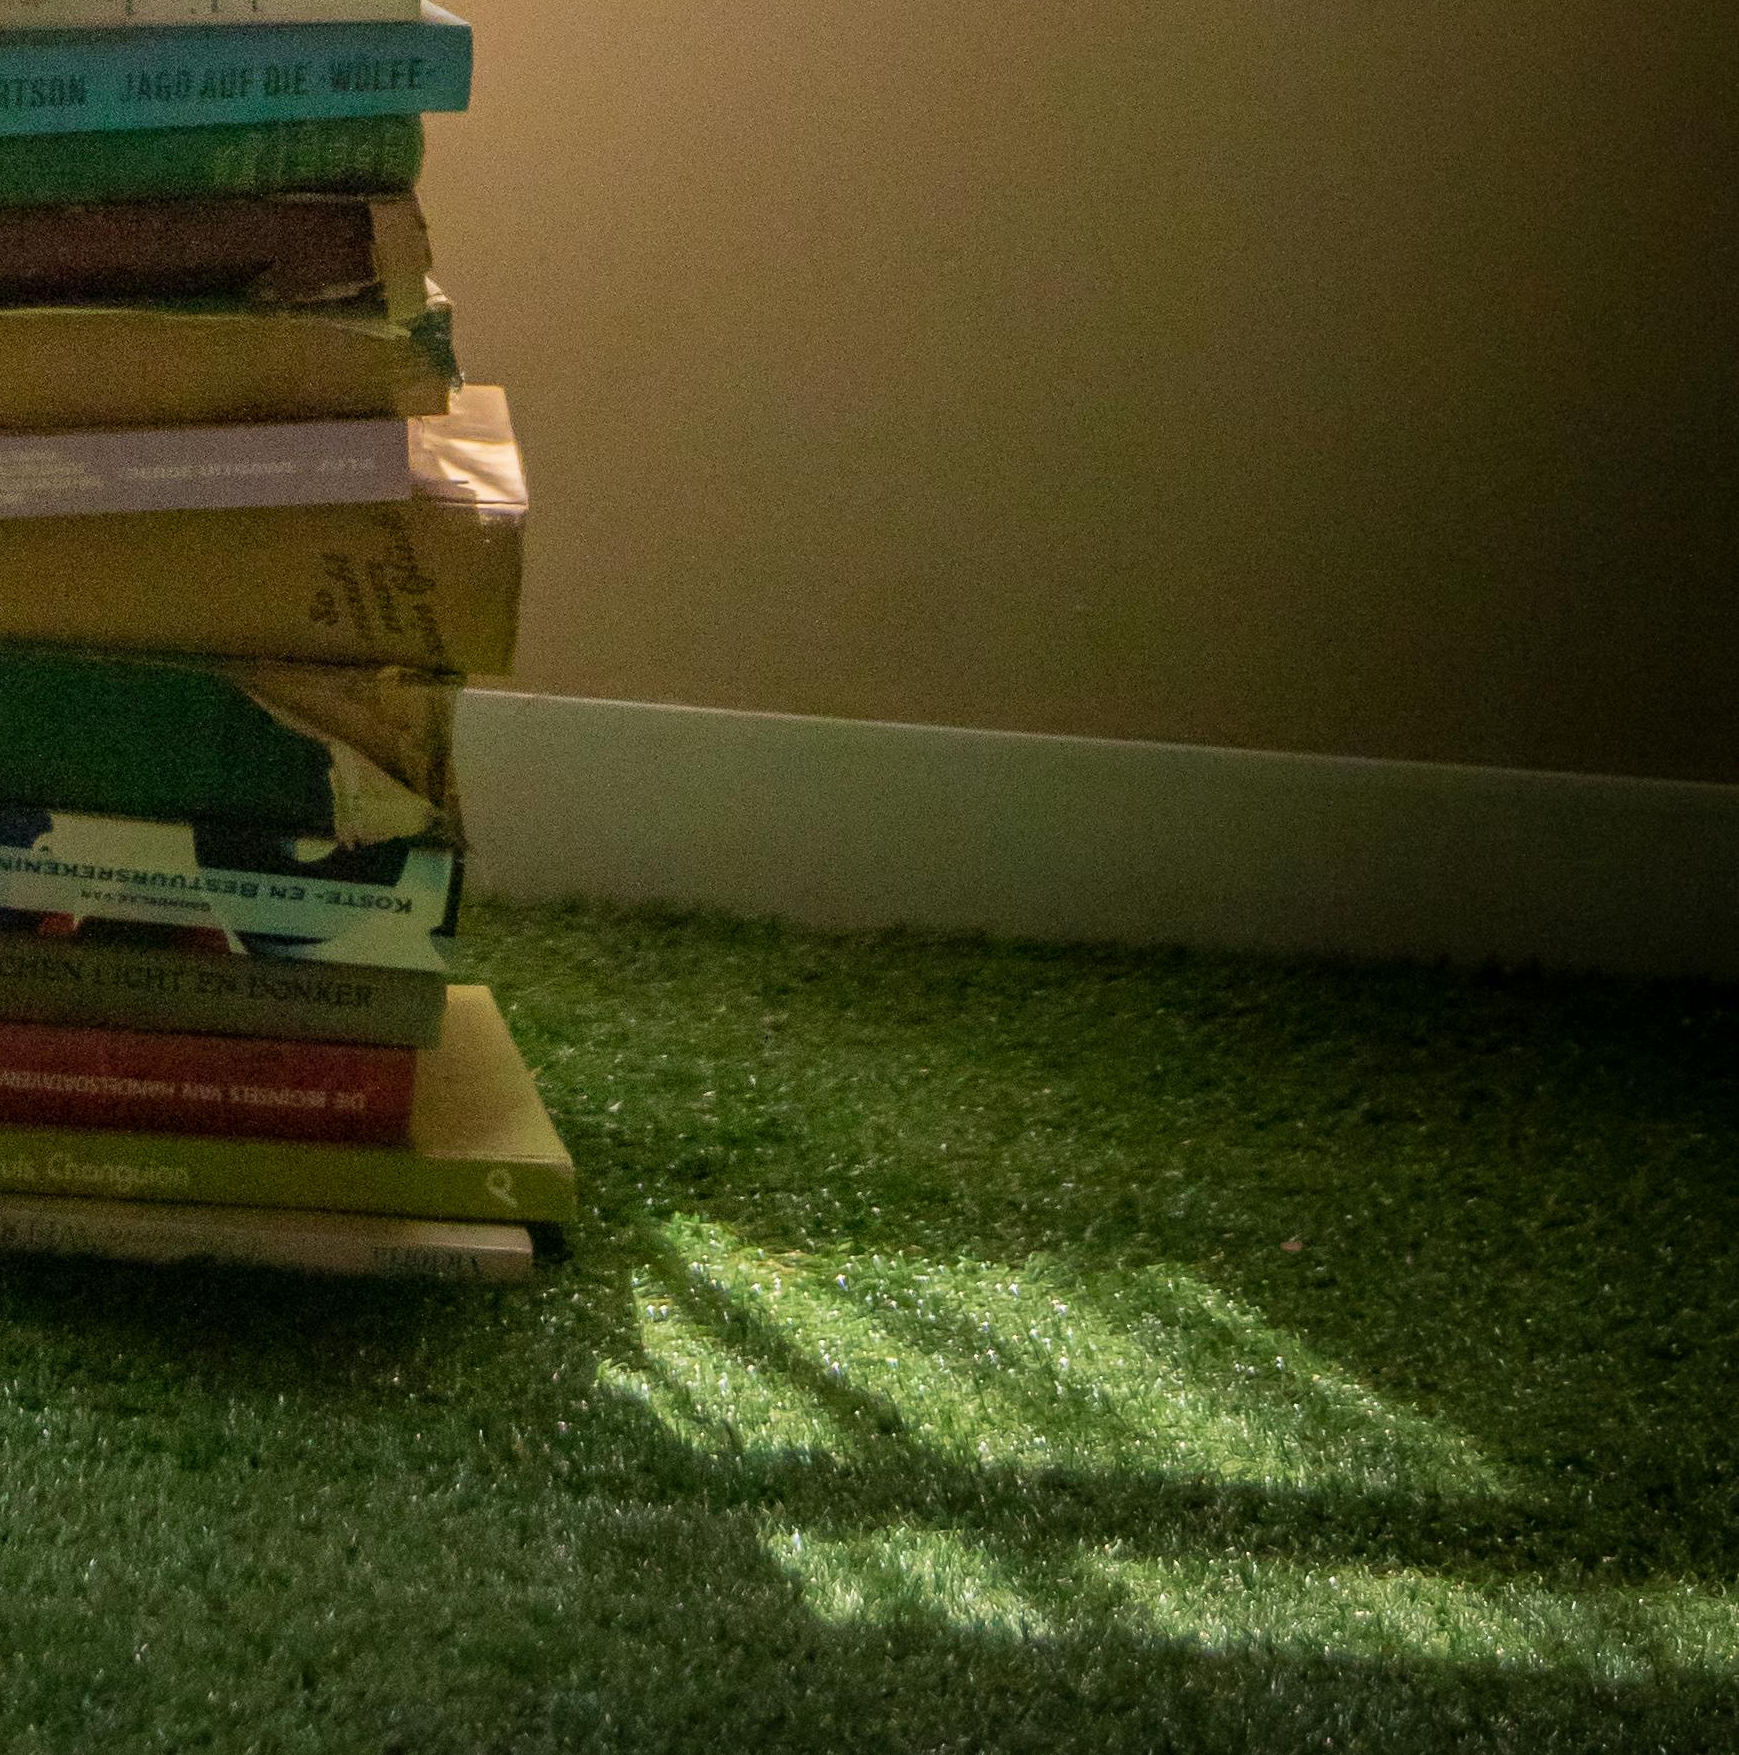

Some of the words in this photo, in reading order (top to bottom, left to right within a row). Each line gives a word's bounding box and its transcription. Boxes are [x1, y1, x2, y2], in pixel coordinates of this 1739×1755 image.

[197, 66, 255, 100] AUF
[257, 64, 308, 97] DIE
[268, 883, 306, 902] EN
[314, 886, 413, 916] KOSTE-
[181, 1080, 223, 1103] VAN
[334, 1090, 367, 1113] DIE
